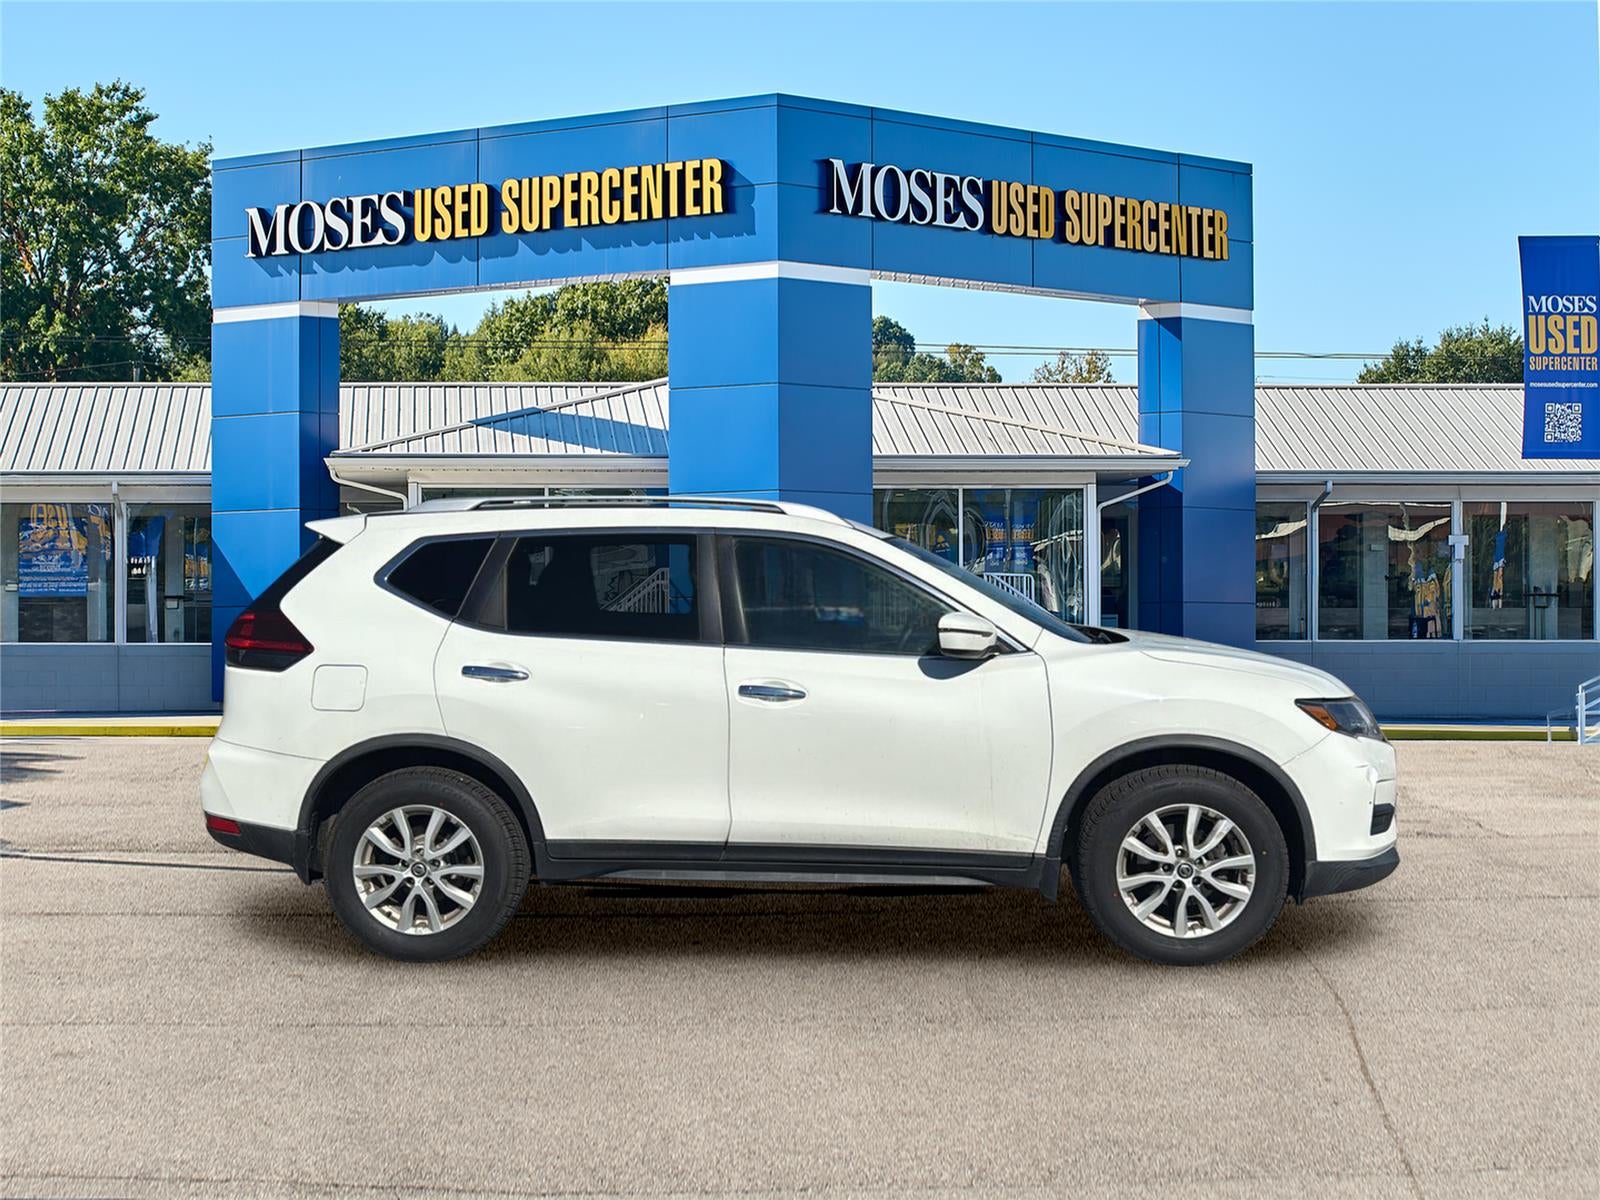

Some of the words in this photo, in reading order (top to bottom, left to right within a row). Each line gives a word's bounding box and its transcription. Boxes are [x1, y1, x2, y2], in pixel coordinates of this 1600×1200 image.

[244, 190, 406, 258] MOSES
[413, 183, 488, 243] USED
[501, 158, 725, 235] SUPERCENTER
[828, 158, 985, 231] MOSES
[991, 179, 1055, 240] USED
[1065, 189, 1229, 261] SUPERCENTER
[1528, 295, 1597, 313] MOSES
[1528, 315, 1598, 355] USED
[1529, 356, 1598, 371] SUPERCENTER
